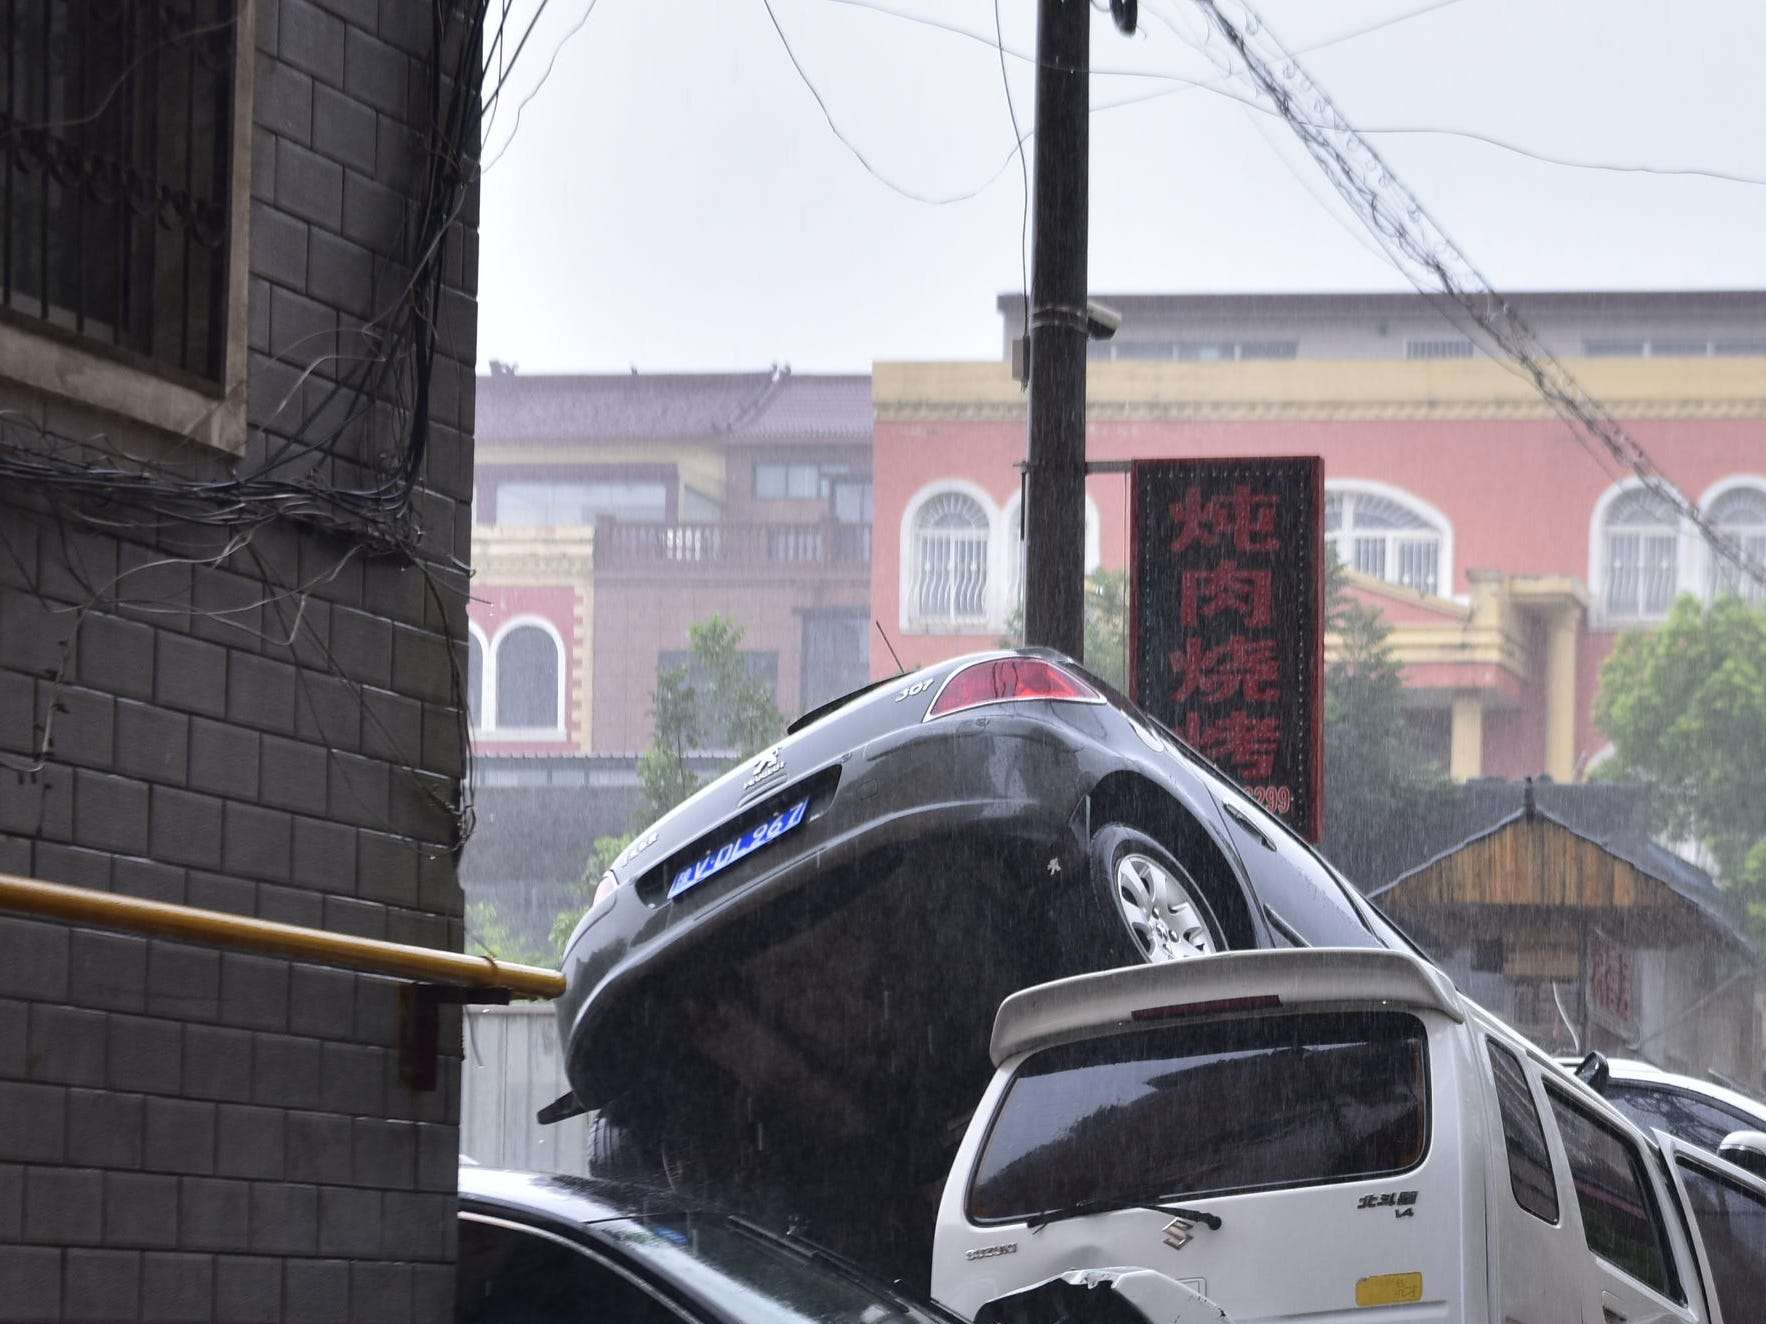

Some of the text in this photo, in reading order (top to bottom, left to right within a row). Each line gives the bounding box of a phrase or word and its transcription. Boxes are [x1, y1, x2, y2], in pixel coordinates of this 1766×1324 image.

[1168, 484, 1281, 779] 炖肉烧烤
[894, 678, 935, 703] 307
[965, 1243, 1019, 1261] SUZUKI
